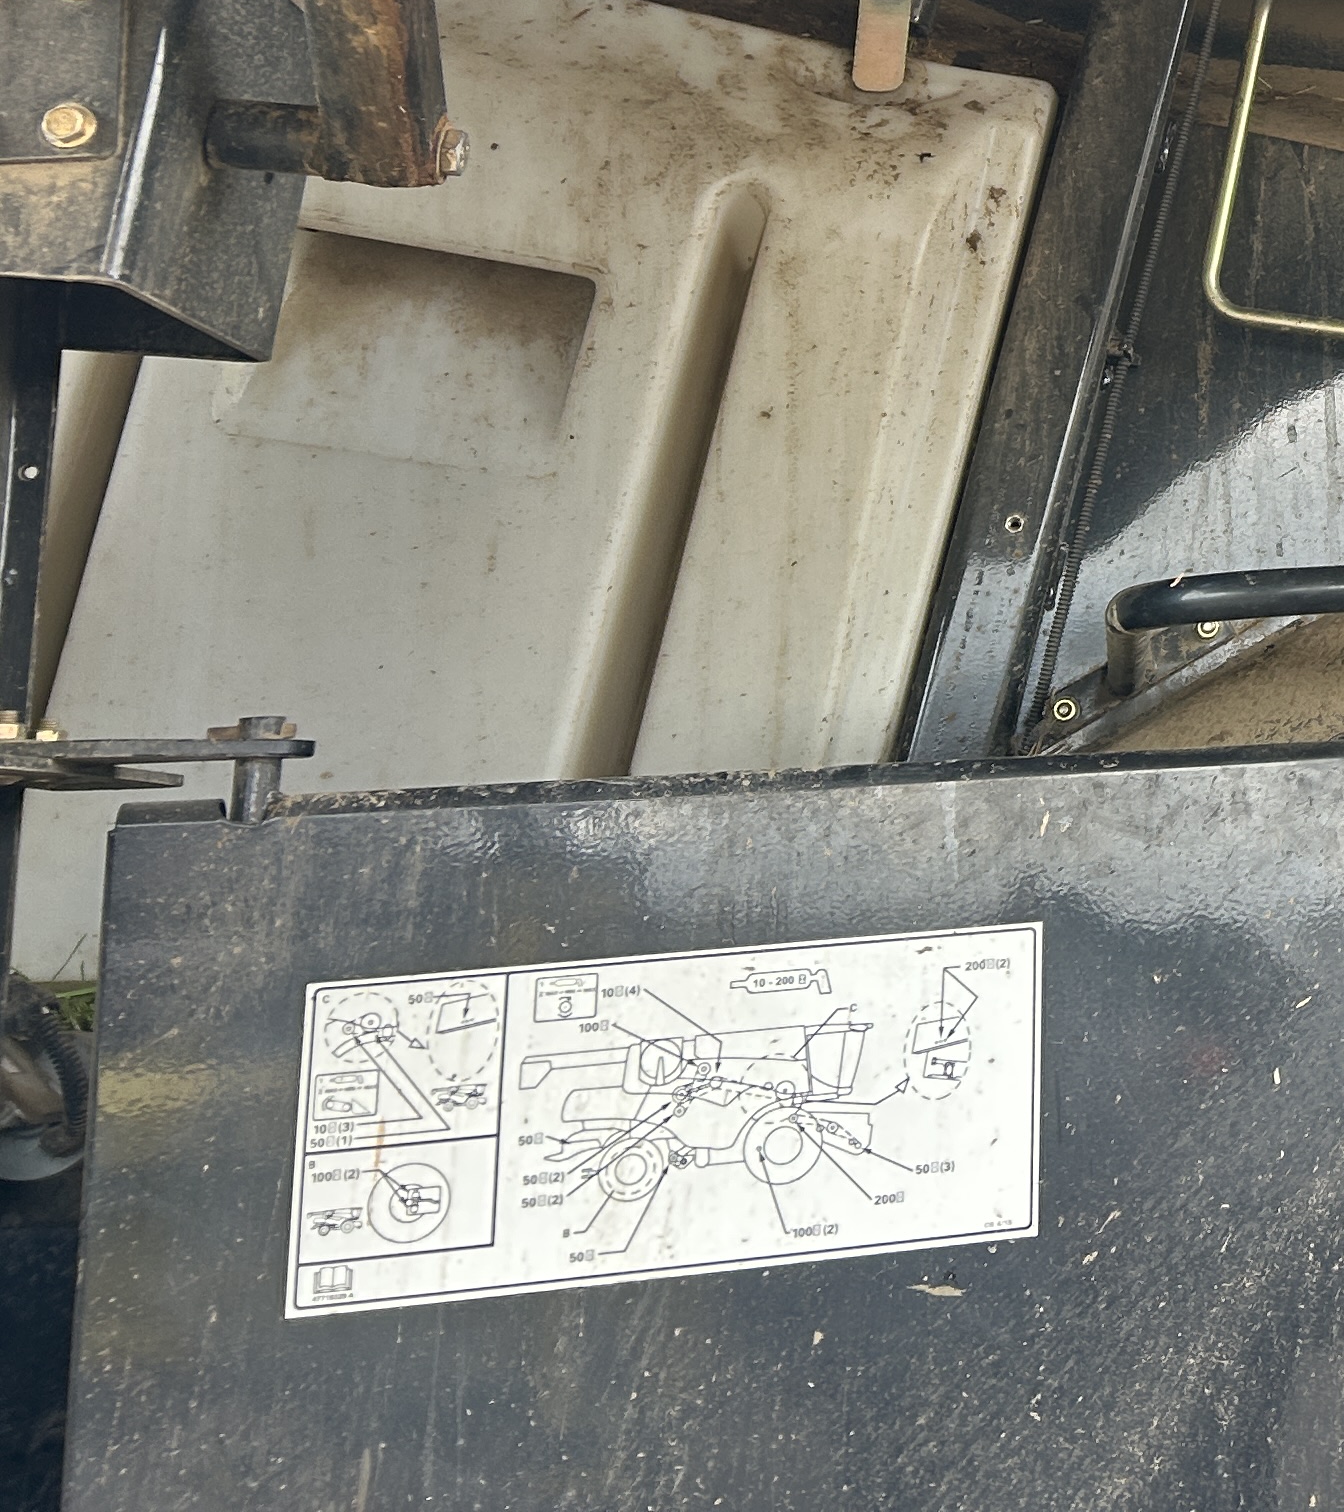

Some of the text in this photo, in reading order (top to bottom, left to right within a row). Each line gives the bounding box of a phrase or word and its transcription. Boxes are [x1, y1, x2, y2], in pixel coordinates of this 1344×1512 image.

[965, 959, 986, 971] 200
[753, 979, 766, 988] 10
[775, 976, 795, 986] 200
[601, 988, 614, 998] 10
[408, 994, 423, 1005] 50
[578, 1022, 600, 1033] 100
[313, 1124, 327, 1134] 10
[310, 1137, 325, 1148] 50
[518, 1135, 533, 1146] 50
[915, 1164, 930, 1174] 50
[311, 1171, 333, 1183] 100
[523, 1174, 538, 1185] 50
[521, 1197, 537, 1208] 50
[873, 1193, 896, 1205] 200
[792, 1226, 813, 1238] 100
[569, 1252, 584, 1263] 50
